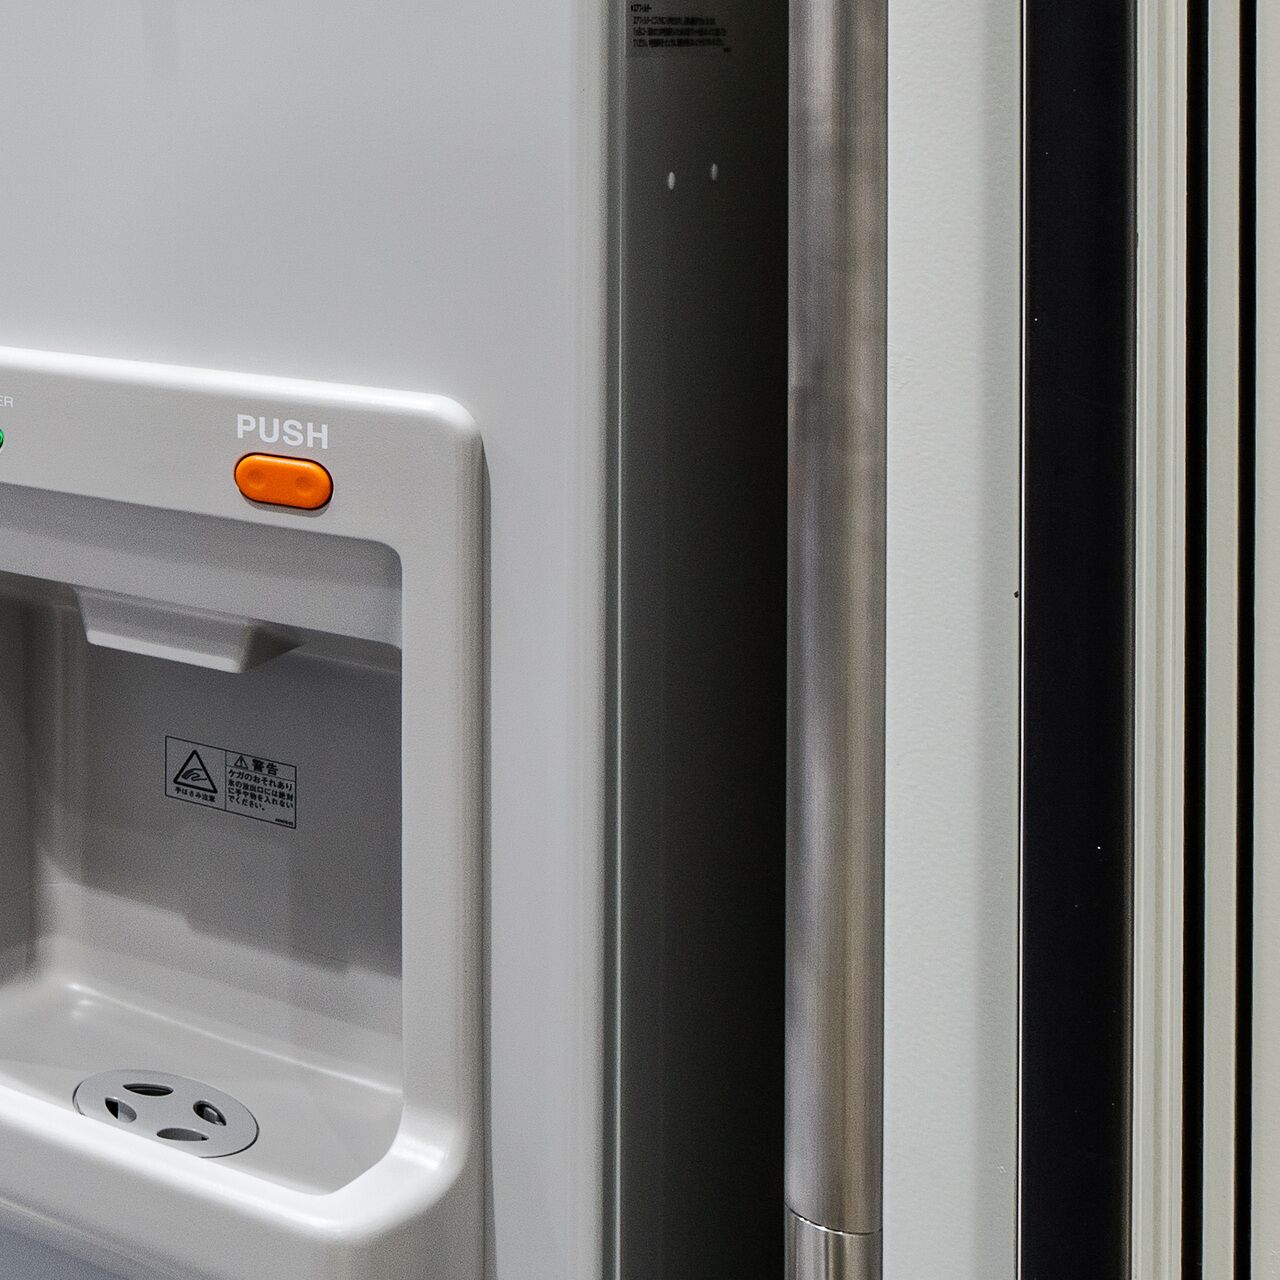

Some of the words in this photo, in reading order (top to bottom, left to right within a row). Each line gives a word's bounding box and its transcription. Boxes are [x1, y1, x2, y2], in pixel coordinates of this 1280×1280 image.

[236, 413, 329, 450] PUSH
[252, 758, 278, 776] 警告
[229, 769, 293, 792] ケガのおそれあり
[228, 795, 265, 811] でください。
